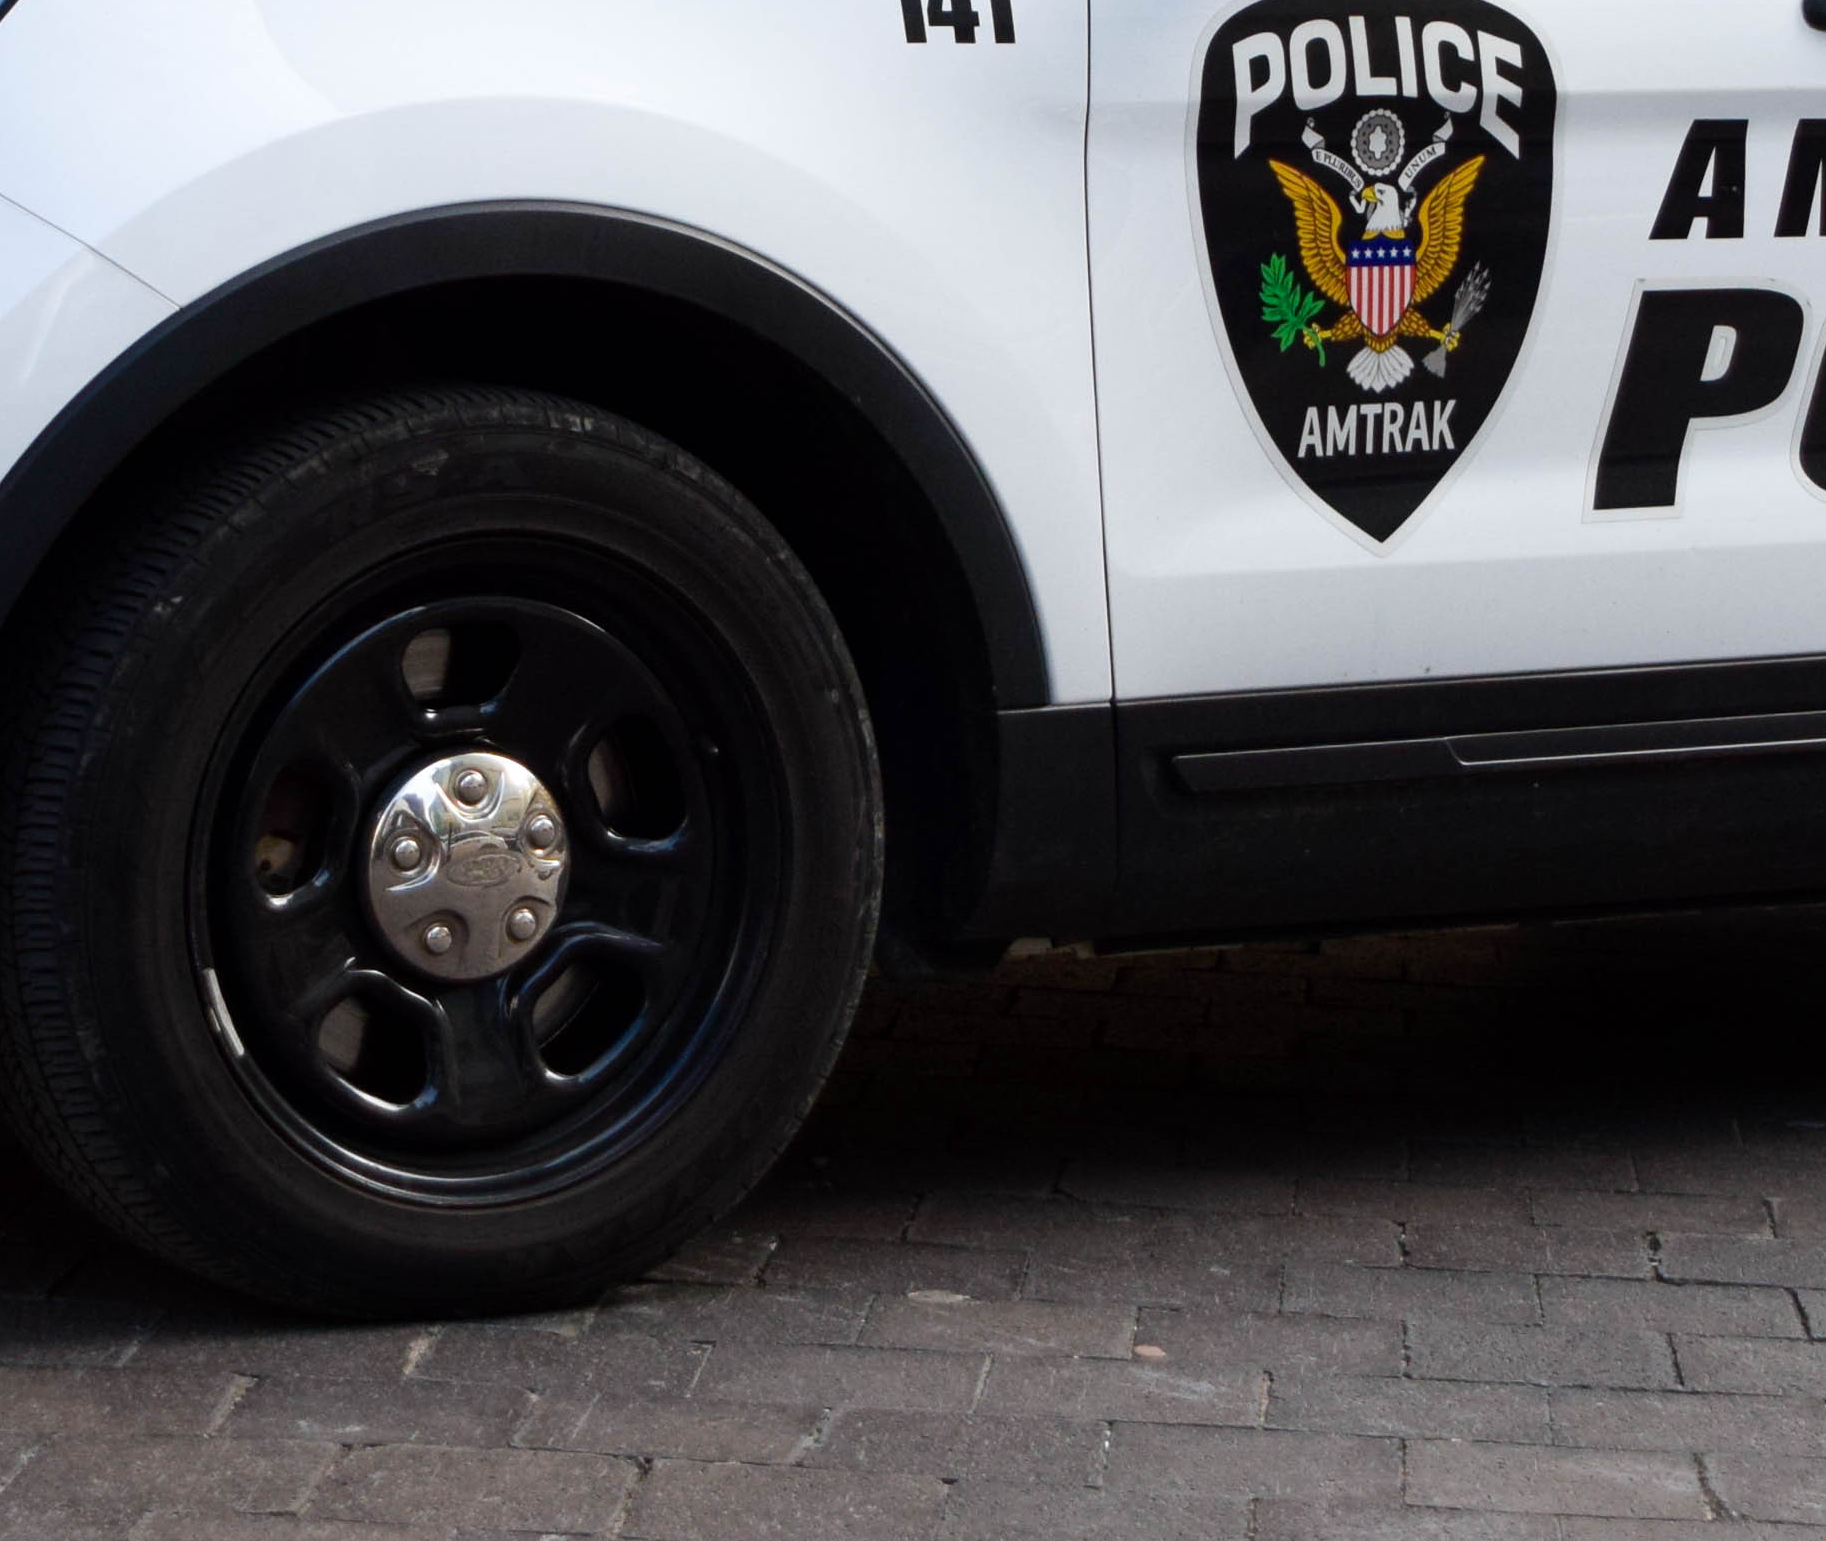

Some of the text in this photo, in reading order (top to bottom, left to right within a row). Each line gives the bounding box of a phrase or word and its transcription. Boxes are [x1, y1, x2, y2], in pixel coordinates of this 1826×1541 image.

[1232, 14, 1525, 160] POLICE
[1323, 152, 1363, 190] PLURIBUS
[1404, 146, 1439, 180] UNUM
[1297, 398, 1457, 459] AMTRAK
